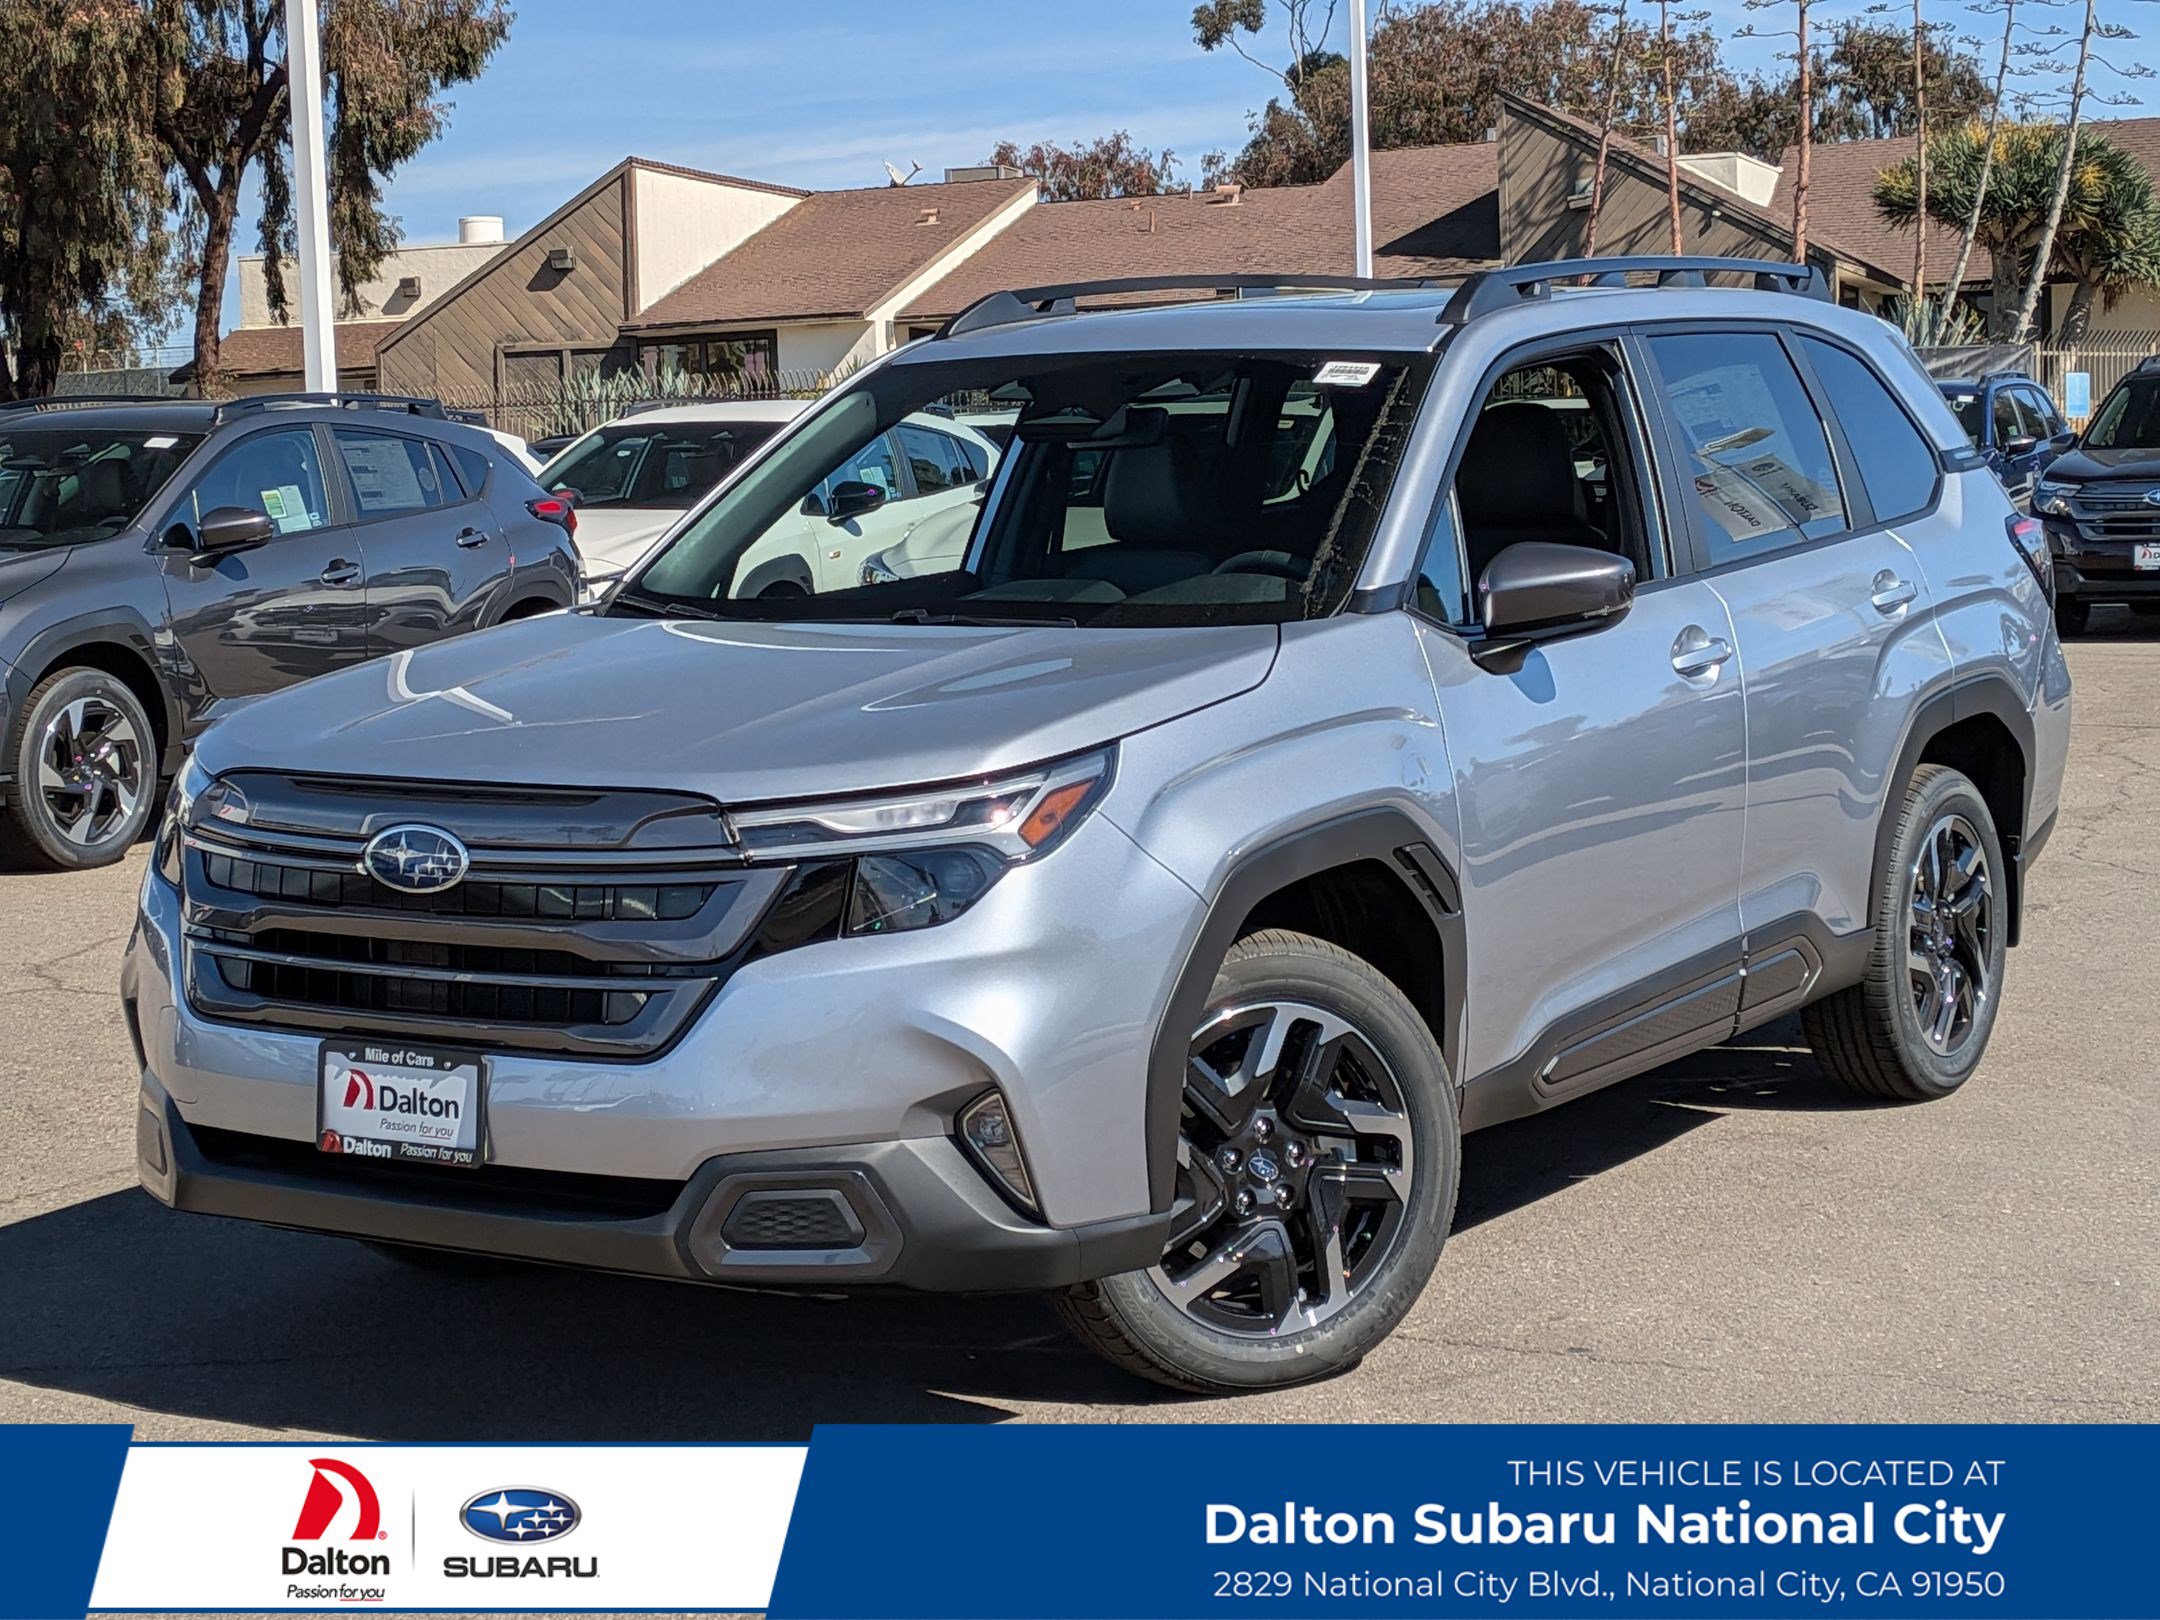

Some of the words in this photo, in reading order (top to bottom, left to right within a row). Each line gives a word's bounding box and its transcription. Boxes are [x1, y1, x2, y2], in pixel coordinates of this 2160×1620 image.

[365, 1047, 389, 1062] Mile
[391, 1051, 404, 1064] of
[406, 1052, 434, 1067] Cars
[379, 1085, 459, 1119] Dalton
[379, 1118, 416, 1131] Passion
[419, 1121, 433, 1135] for
[434, 1126, 454, 1138] you
[343, 1136, 392, 1159] Dalton
[400, 1143, 437, 1158] Passion
[438, 1148, 452, 1161] for
[452, 1152, 473, 1164] you
